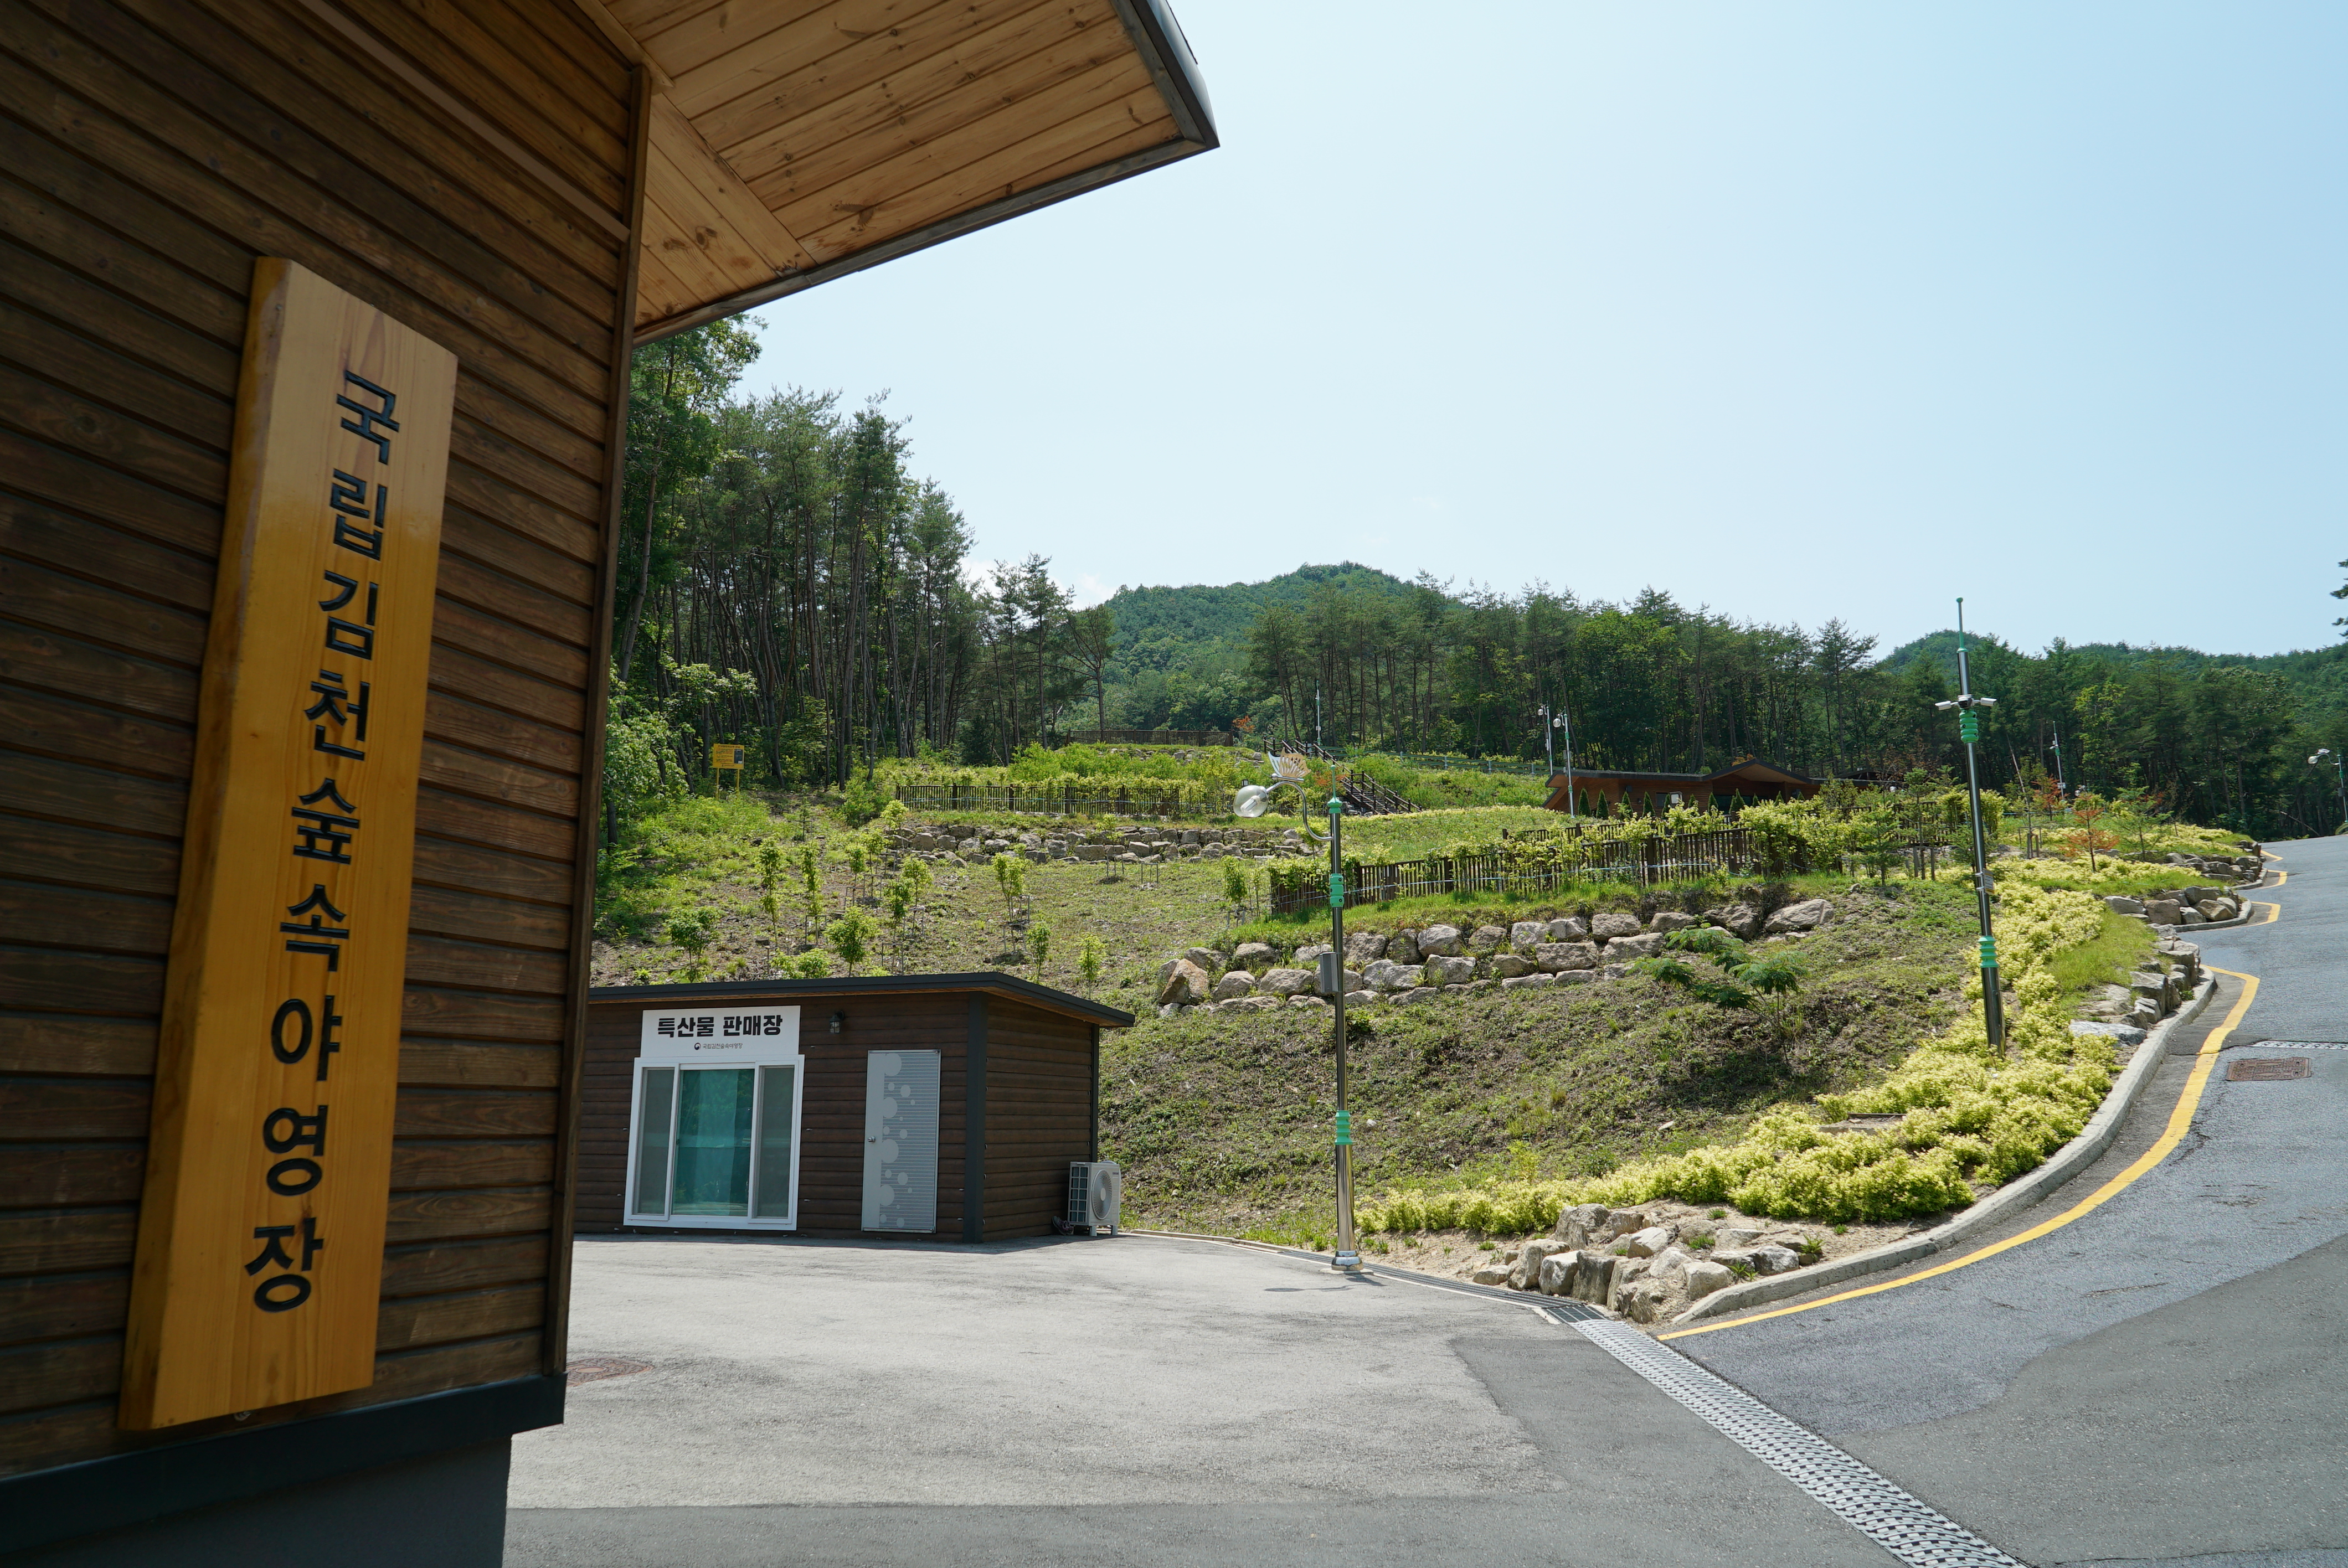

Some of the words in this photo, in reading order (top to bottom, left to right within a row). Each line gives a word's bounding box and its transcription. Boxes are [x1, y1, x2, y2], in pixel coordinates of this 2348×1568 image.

[244, 369, 400, 1313] 국립김천숲속야영장
[657, 1017, 714, 1038] 특산물
[723, 1014, 783, 1036] 판매장
